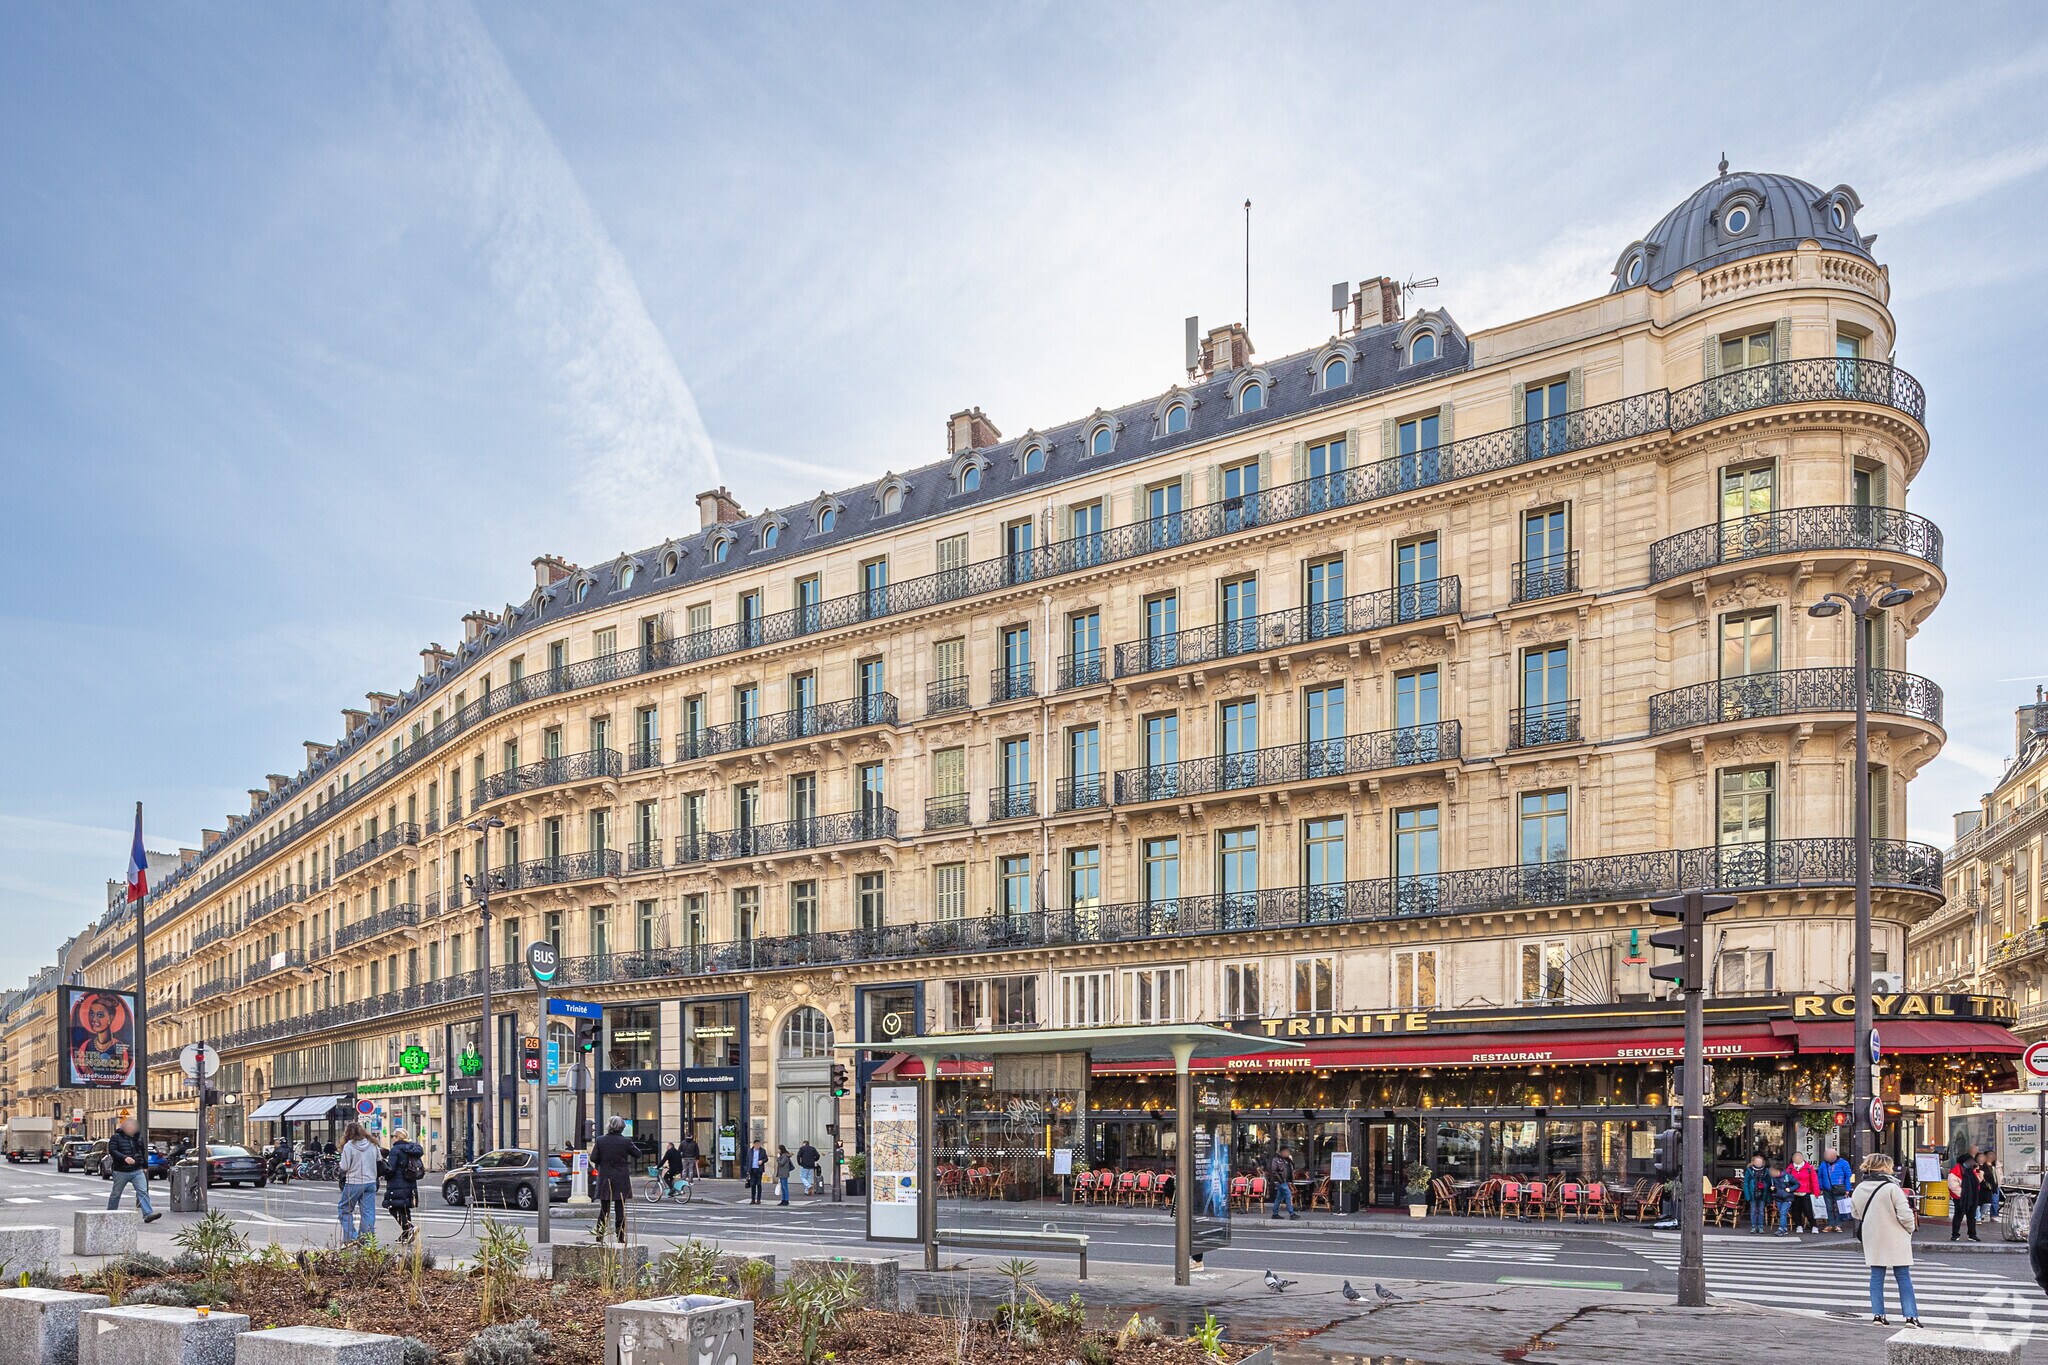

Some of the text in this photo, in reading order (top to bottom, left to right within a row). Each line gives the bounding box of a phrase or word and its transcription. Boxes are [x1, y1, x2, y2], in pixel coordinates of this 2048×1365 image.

[534, 950, 554, 964] BUS
[566, 1004, 588, 1013] Trinité
[1794, 995, 2020, 1019] ROYAL TRIN
[1261, 1014, 1428, 1037] TRINITE
[527, 1039, 537, 1047] 26
[1617, 1045, 1742, 1057] SERVICE CNTINU
[1472, 1052, 1552, 1062] RESTAURANT
[526, 1060, 538, 1068] 43
[1228, 1058, 1311, 1068] ROYAL TRINITE
[615, 1076, 641, 1088] JOYA
